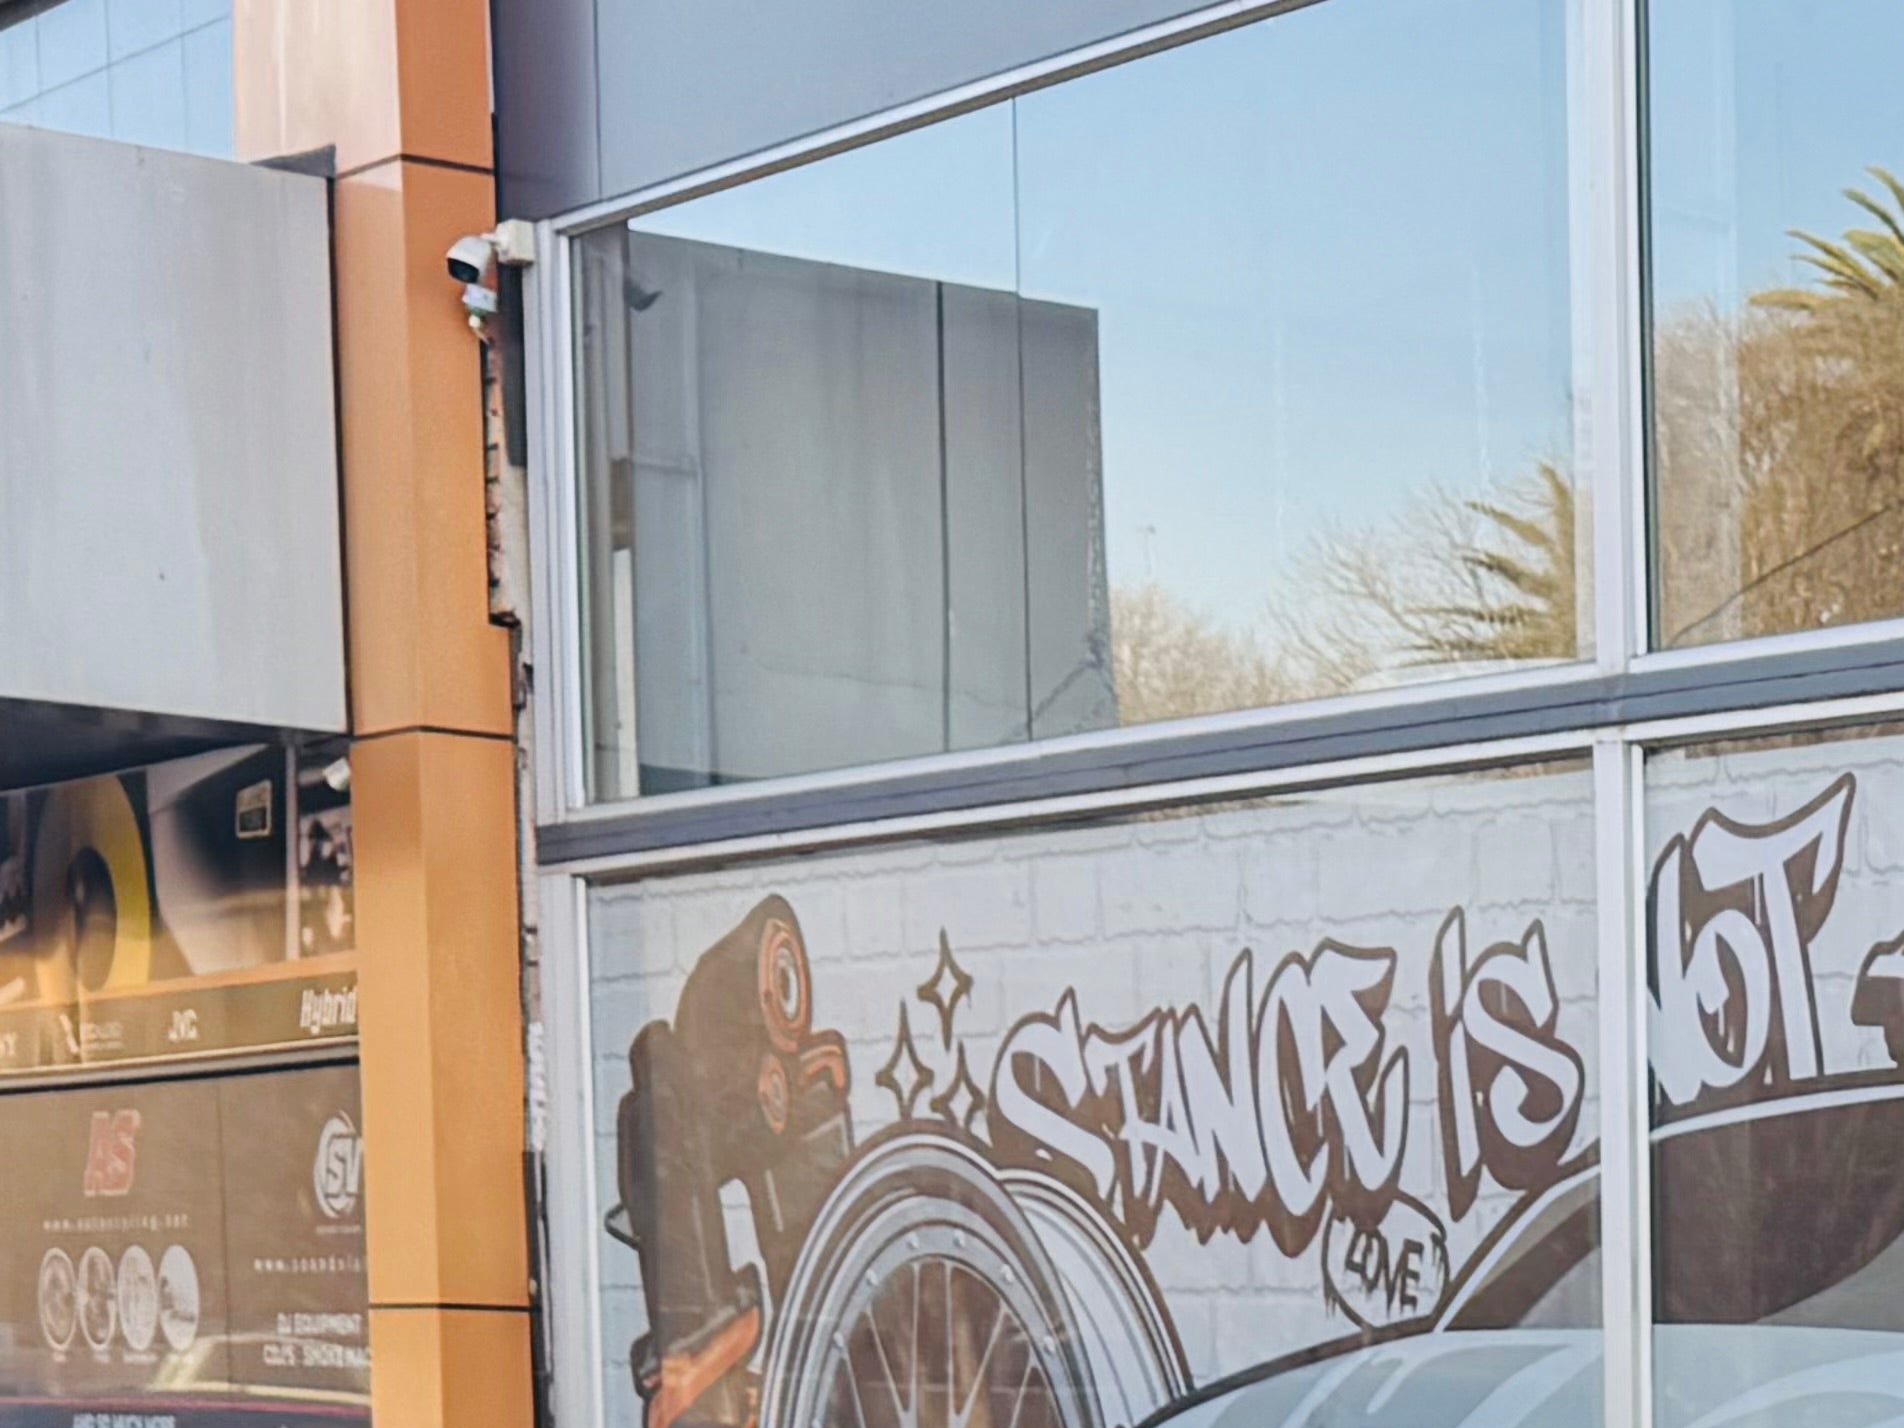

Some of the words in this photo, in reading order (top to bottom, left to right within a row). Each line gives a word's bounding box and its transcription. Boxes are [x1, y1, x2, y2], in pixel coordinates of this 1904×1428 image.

[988, 937, 1409, 1257] STANCE
[1429, 905, 1586, 1222] IS
[1345, 1229, 1425, 1316] LOVE
